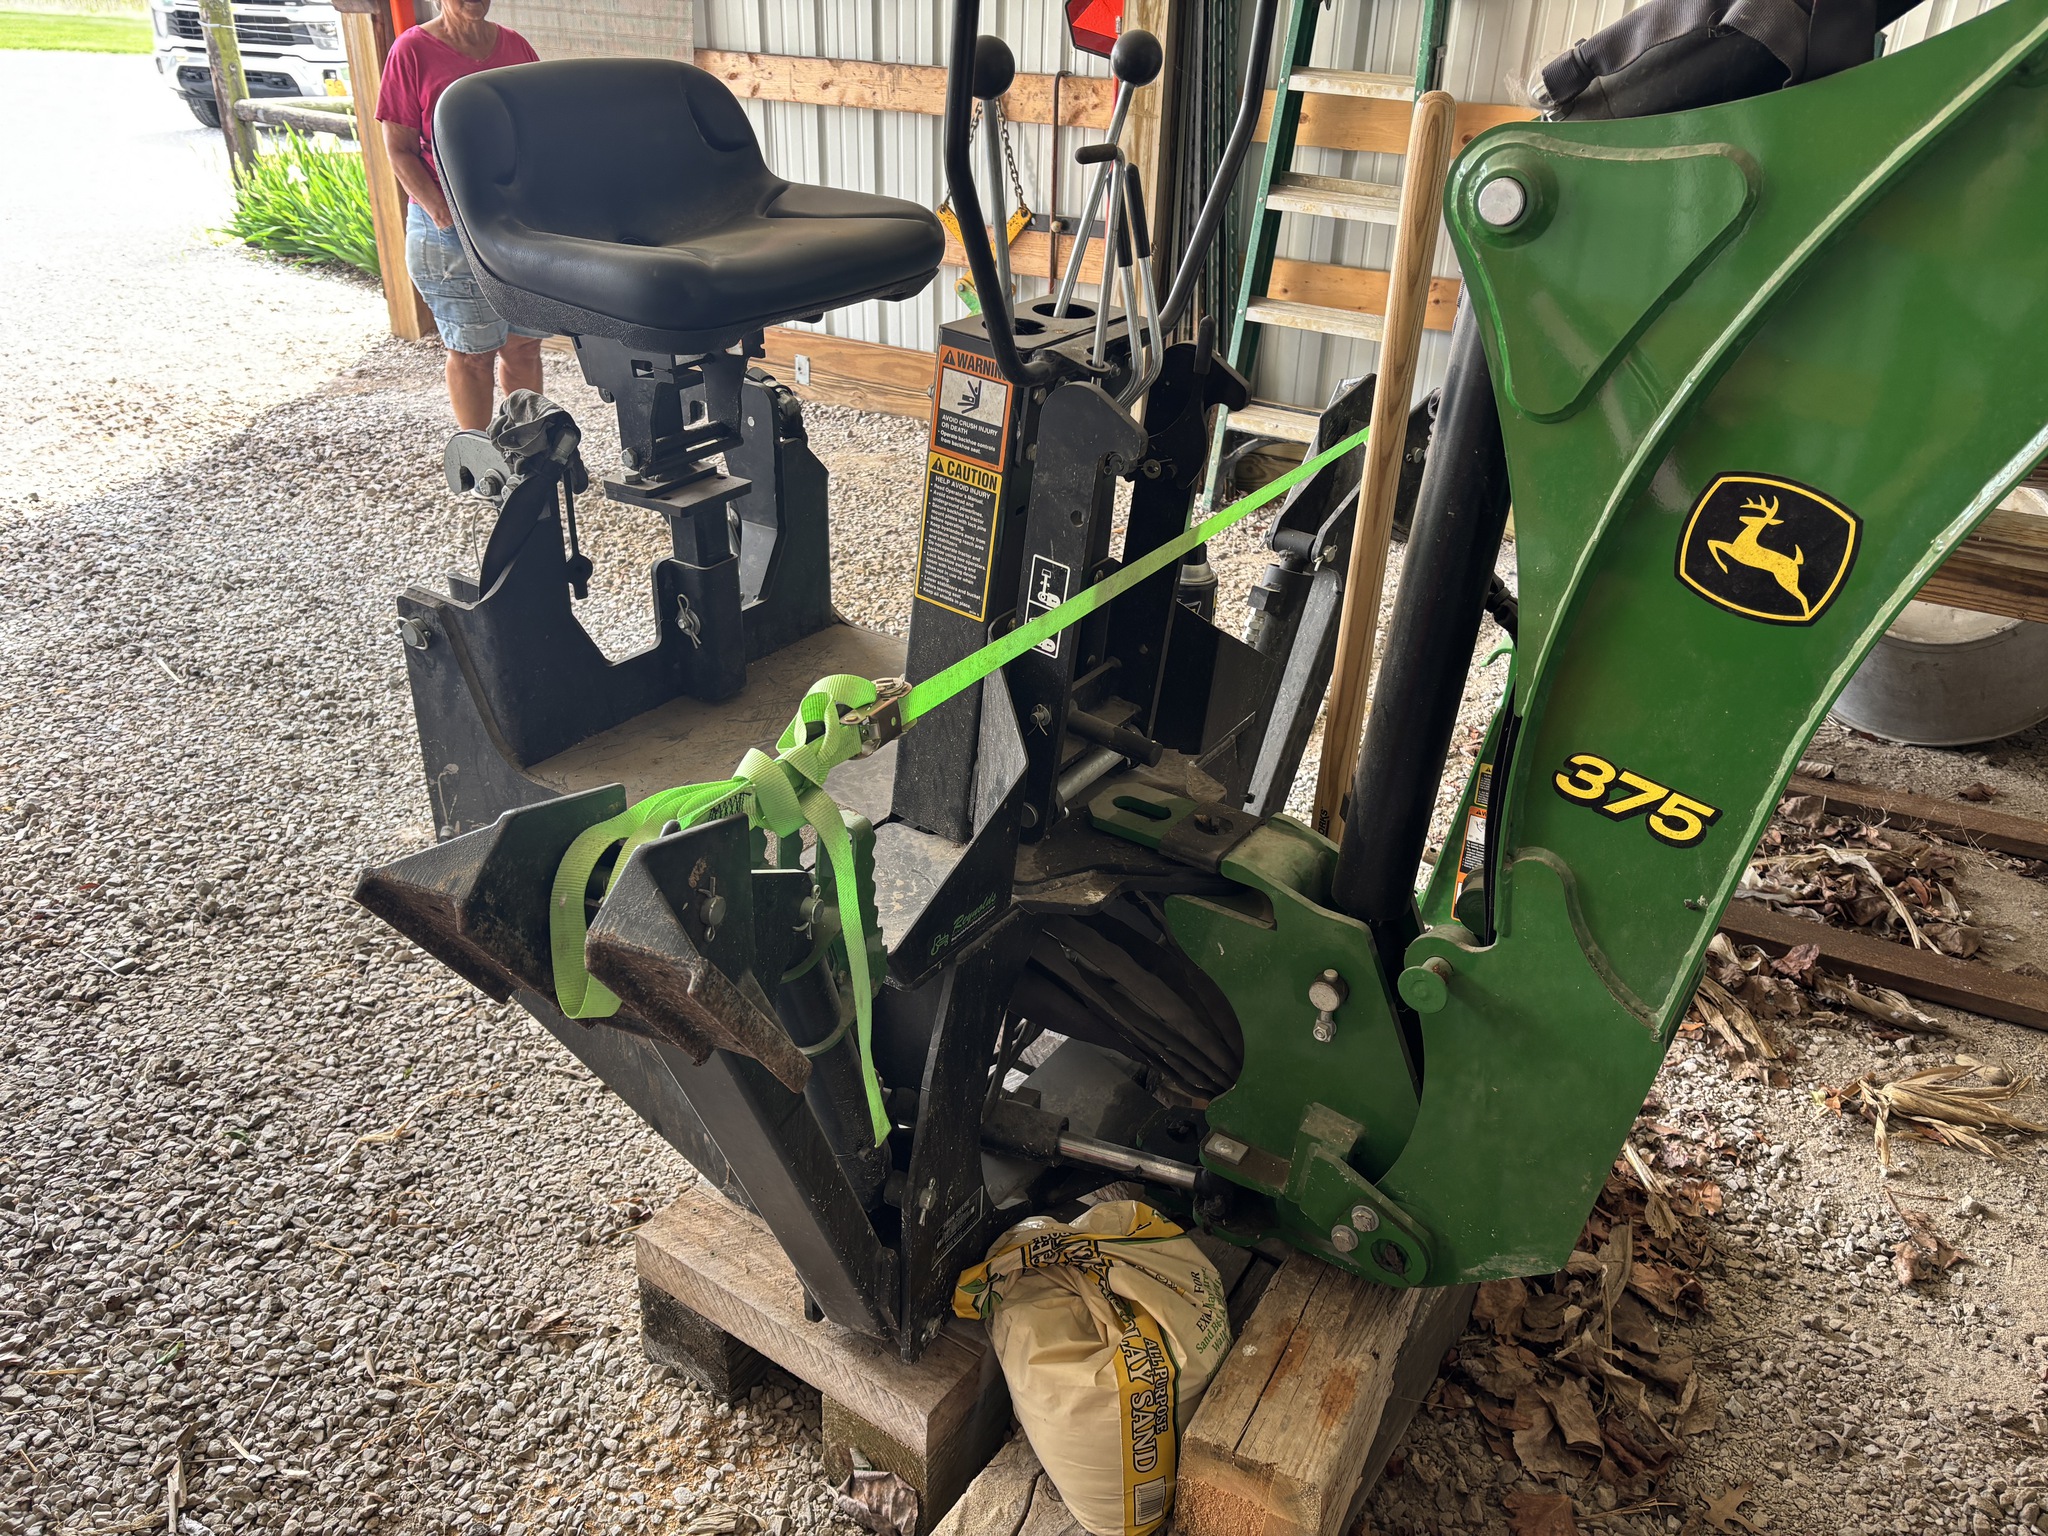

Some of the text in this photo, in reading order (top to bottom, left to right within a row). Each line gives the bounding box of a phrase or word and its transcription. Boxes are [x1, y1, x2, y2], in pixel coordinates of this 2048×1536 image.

[957, 351, 1009, 381] WARNIN
[941, 414, 998, 436] AVOID CRUSH INJURY
[941, 421, 968, 435] OR DEATH
[940, 429, 996, 452] Operate backhoe controls
[940, 436, 951, 444] from
[951, 440, 970, 451] backhoe
[946, 460, 997, 490] CAUTION
[933, 483, 983, 505] Read Operator's Manual.
[933, 489, 946, 498] Avoid
[945, 494, 966, 505] overhead
[935, 475, 991, 499] HELP AVOID INJURY
[930, 514, 964, 531] before operating.
[931, 502, 946, 511] Secure
[946, 507, 964, 518] backhoe
[969, 515, 984, 524] tractor
[929, 521, 986, 545] Keep bystanders away from
[937, 536, 958, 547] stabilizers.
[926, 551, 937, 559] Lock
[937, 555, 955, 565] backhoe
[954, 562, 968, 571] swing
[941, 544, 958, 554] operate
[957, 550, 972, 559] tractor
[924, 569, 950, 583] transporting.
[925, 557, 938, 565] boom
[947, 565, 963, 576] locking
[962, 571, 977, 580] device
[925, 563, 937, 571] when
[962, 577, 974, 585] when
[922, 586, 933, 595] Keep
[939, 593, 954, 602] shields
[923, 574, 937, 583] Lower
[937, 580, 958, 591] stabilizers
[966, 591, 981, 600] bucket
[923, 580, 937, 589] before
[936, 585, 952, 596] leaving
[1553, 753, 1721, 847] 375
[1317, 808, 1330, 836] ORKS
[1191, 1271, 1205, 1294] FOR
[1195, 1331, 1214, 1354] Sand
[1143, 1338, 1169, 1435] ALL PURPOSE
[1131, 1390, 1158, 1473] SAND
